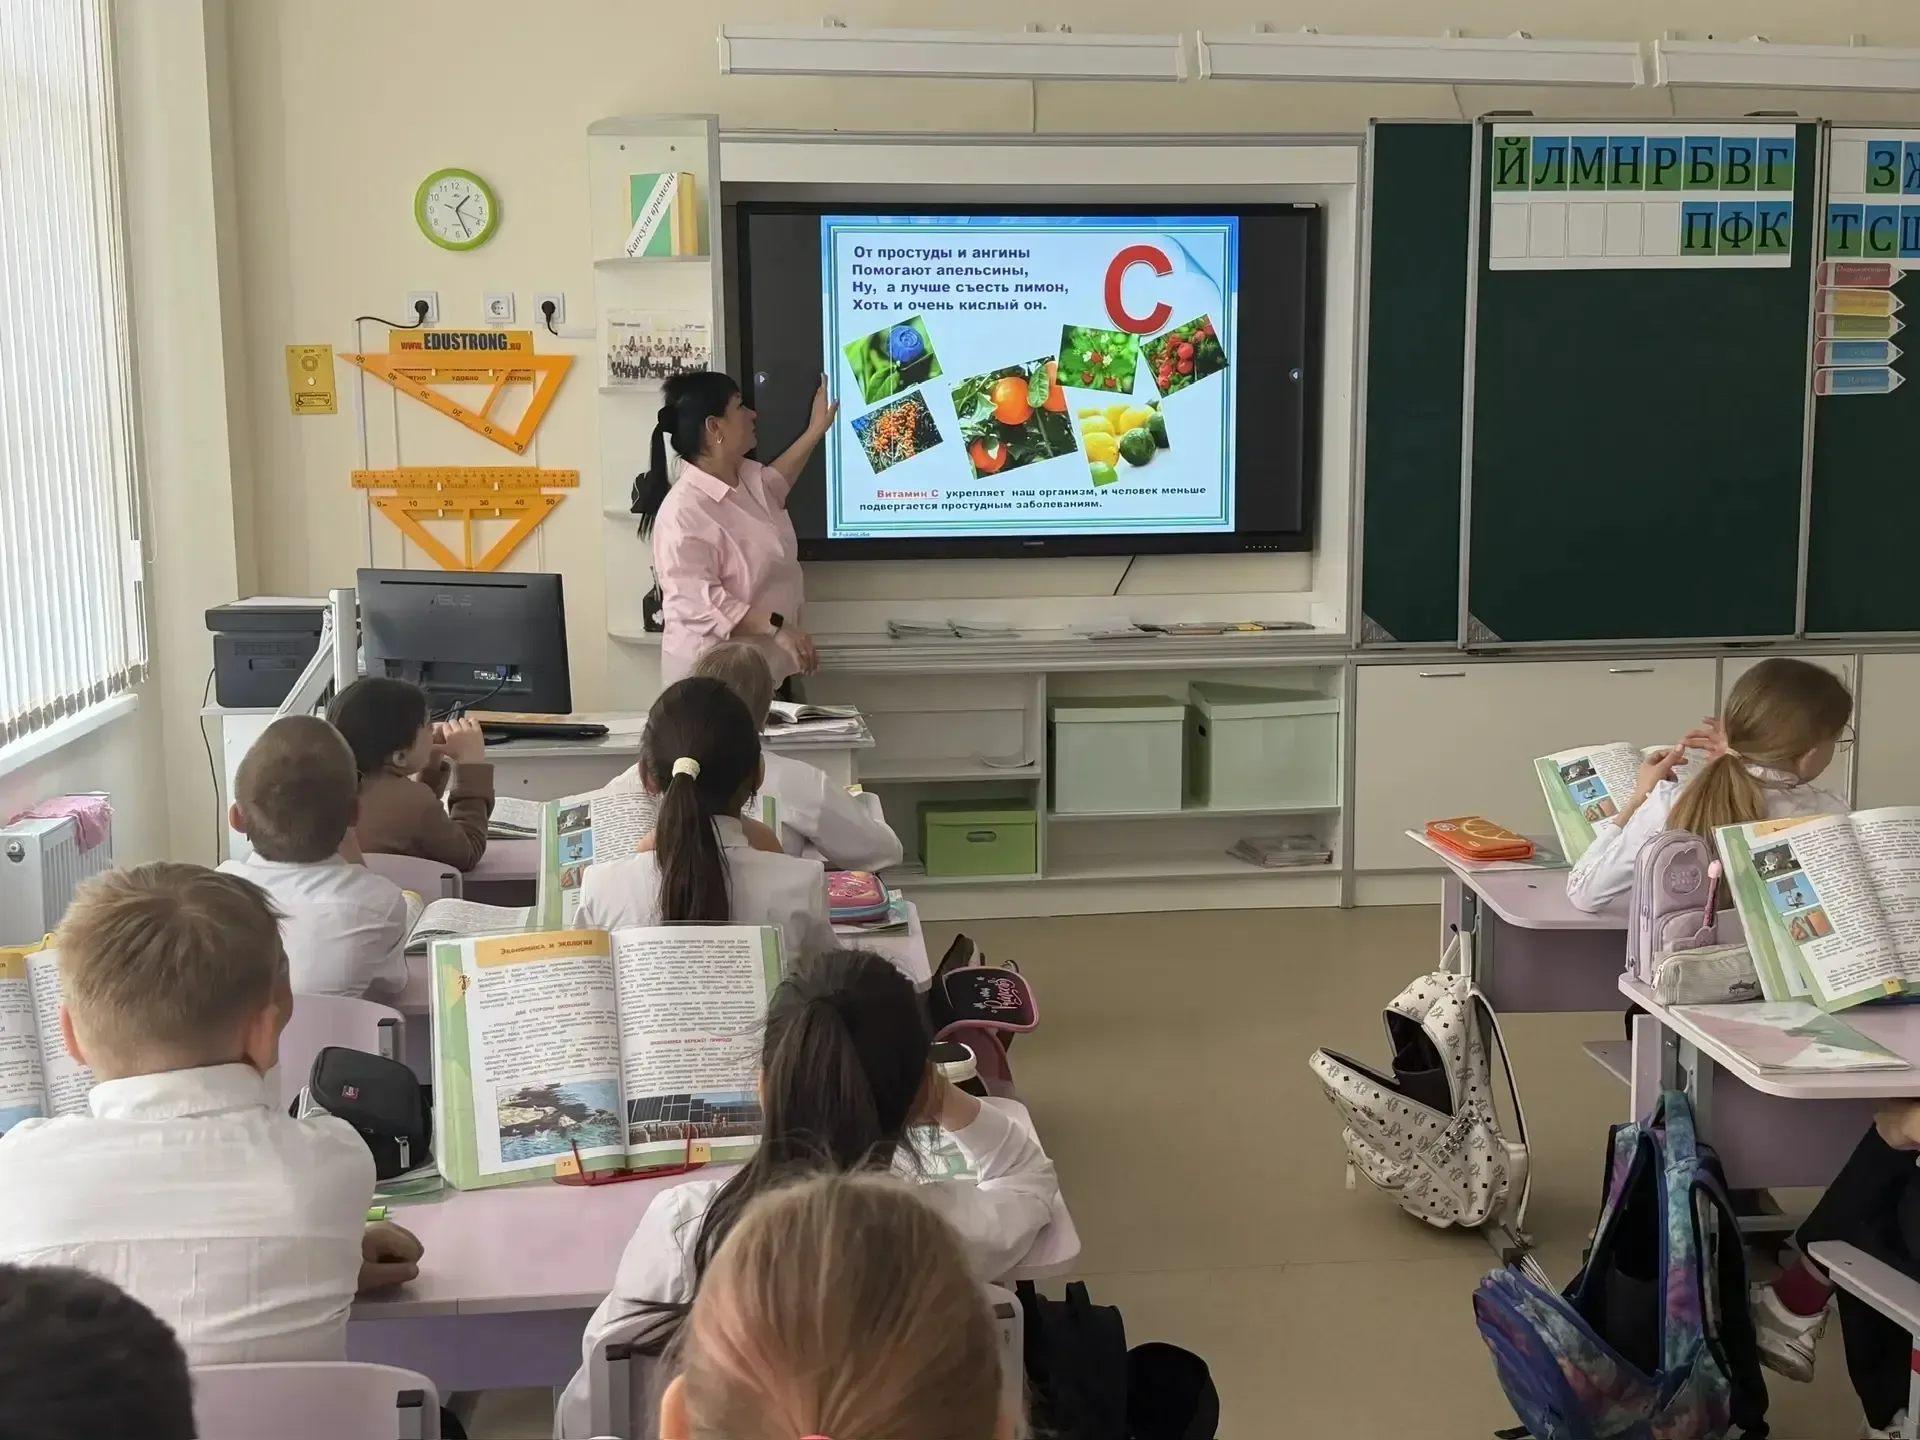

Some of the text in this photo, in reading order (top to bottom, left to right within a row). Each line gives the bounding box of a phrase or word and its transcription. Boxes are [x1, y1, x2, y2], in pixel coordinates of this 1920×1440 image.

[627, 173, 675, 257] Капсула времени
[853, 246, 1031, 261] От простуды и ангины
[852, 264, 1029, 278] Помогают апельсины,
[852, 281, 1069, 294] Ну, а лучше съесть лимон,
[852, 298, 1047, 311] Хоть и очень кислый он.
[451, 374, 479, 382] УДОБНО
[876, 485, 1207, 500] Витамин С укрепляет наш организм, и человек меньше
[859, 498, 1103, 512] подвергается простудным заболеваниям.
